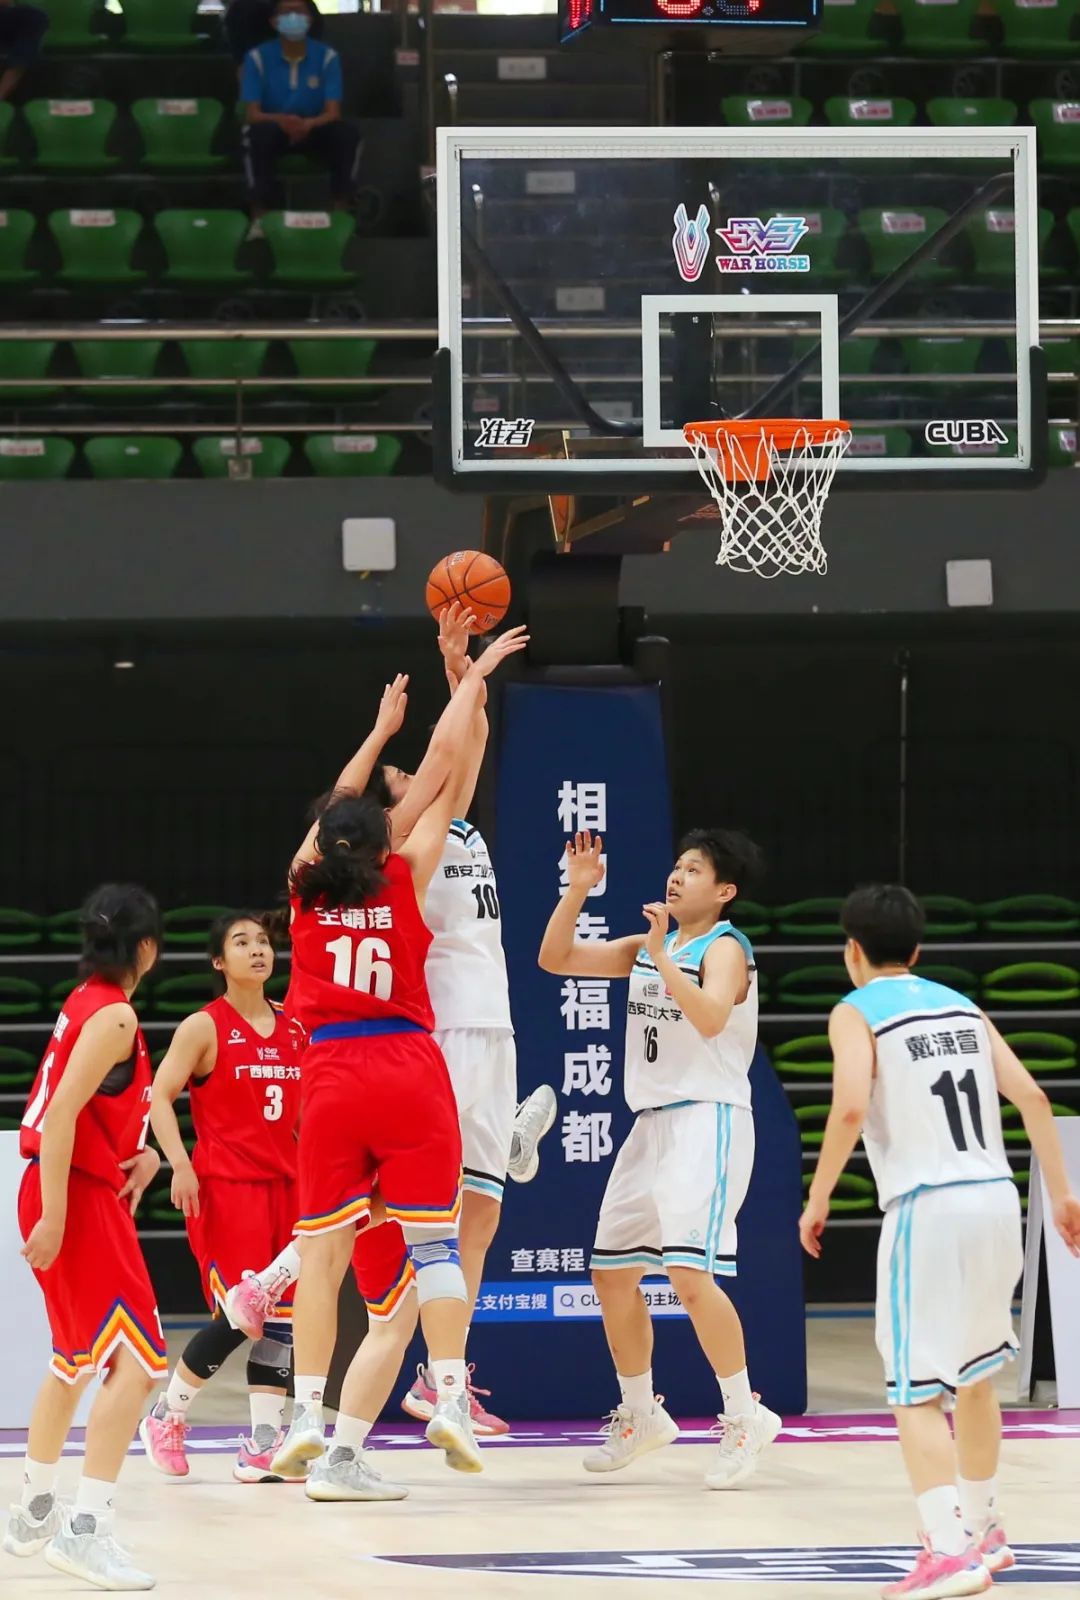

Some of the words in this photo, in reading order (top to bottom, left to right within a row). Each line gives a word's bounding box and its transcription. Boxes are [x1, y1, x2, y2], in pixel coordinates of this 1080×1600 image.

[717, 257, 752, 271] WAR
[754, 257, 809, 271] HORSE
[474, 418, 535, 447] 准者
[925, 420, 1009, 445] CUBA
[471, 883, 499, 920] 10
[325, 934, 393, 1002] 16
[263, 1084, 283, 1121] 3
[930, 1068, 987, 1152] 11
[511, 1248, 586, 1272] 查赛程
